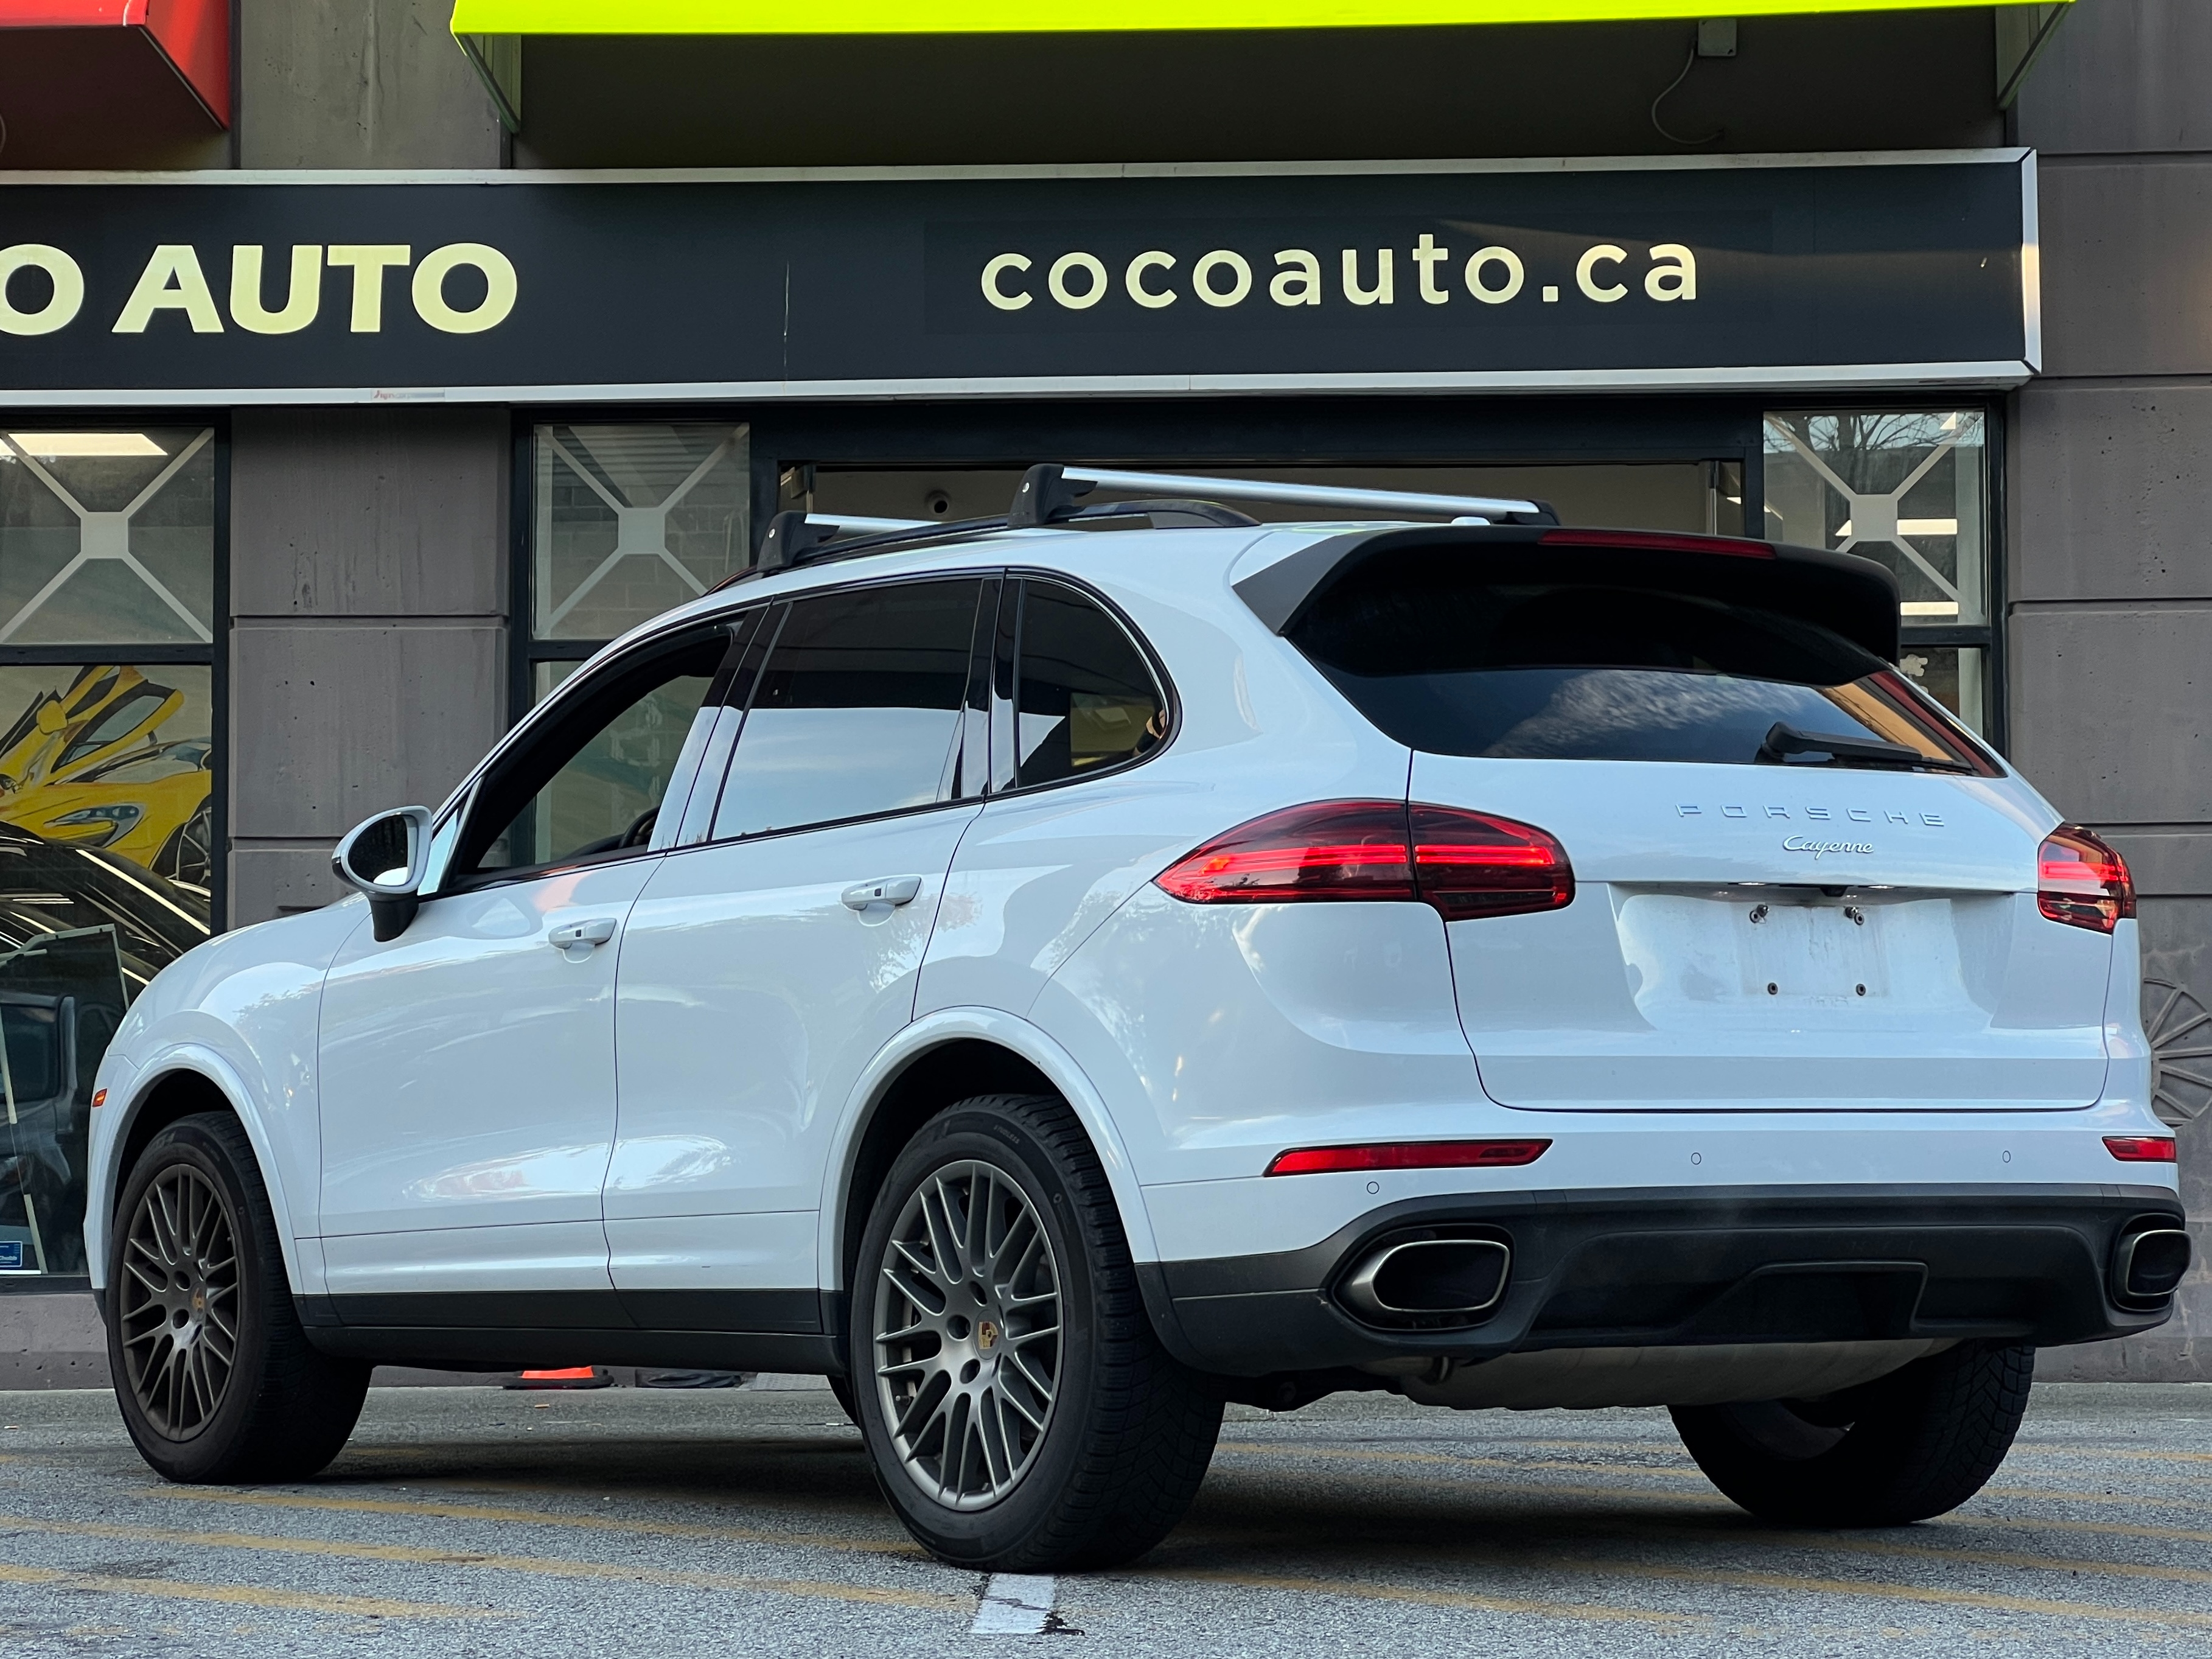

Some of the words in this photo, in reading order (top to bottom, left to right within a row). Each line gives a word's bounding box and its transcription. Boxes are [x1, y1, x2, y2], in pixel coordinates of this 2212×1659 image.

[0, 243, 85, 336] O
[111, 242, 518, 335] AUTO
[981, 234, 1697, 310] cocoauto.ca
[1675, 803, 1945, 827] PORSCHE
[1782, 835, 1875, 860] Cayenne
